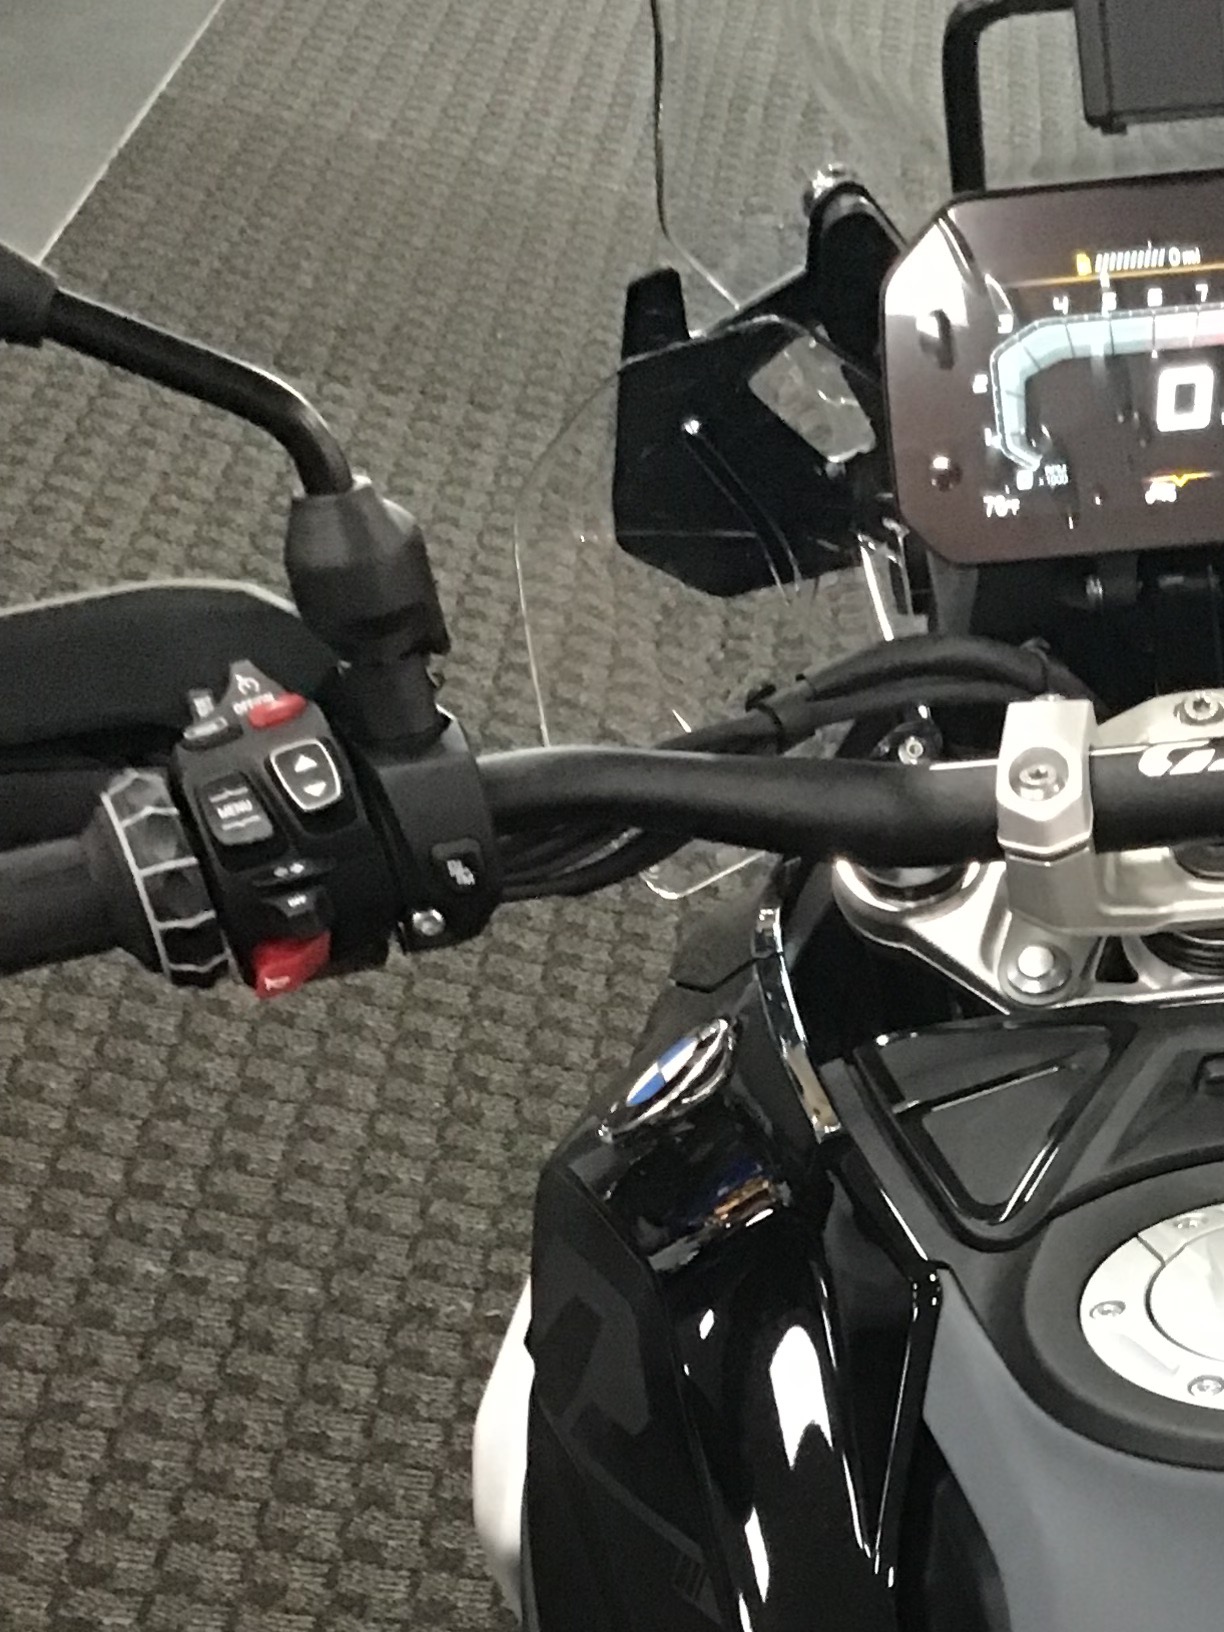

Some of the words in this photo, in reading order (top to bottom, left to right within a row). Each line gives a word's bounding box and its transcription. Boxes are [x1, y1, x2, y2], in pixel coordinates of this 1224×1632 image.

[1168, 246, 1181, 267] 0
[1195, 283, 1209, 302] 7
[1053, 295, 1069, 315] 4
[1156, 363, 1215, 432] 0
[216, 799, 253, 819] MENU
